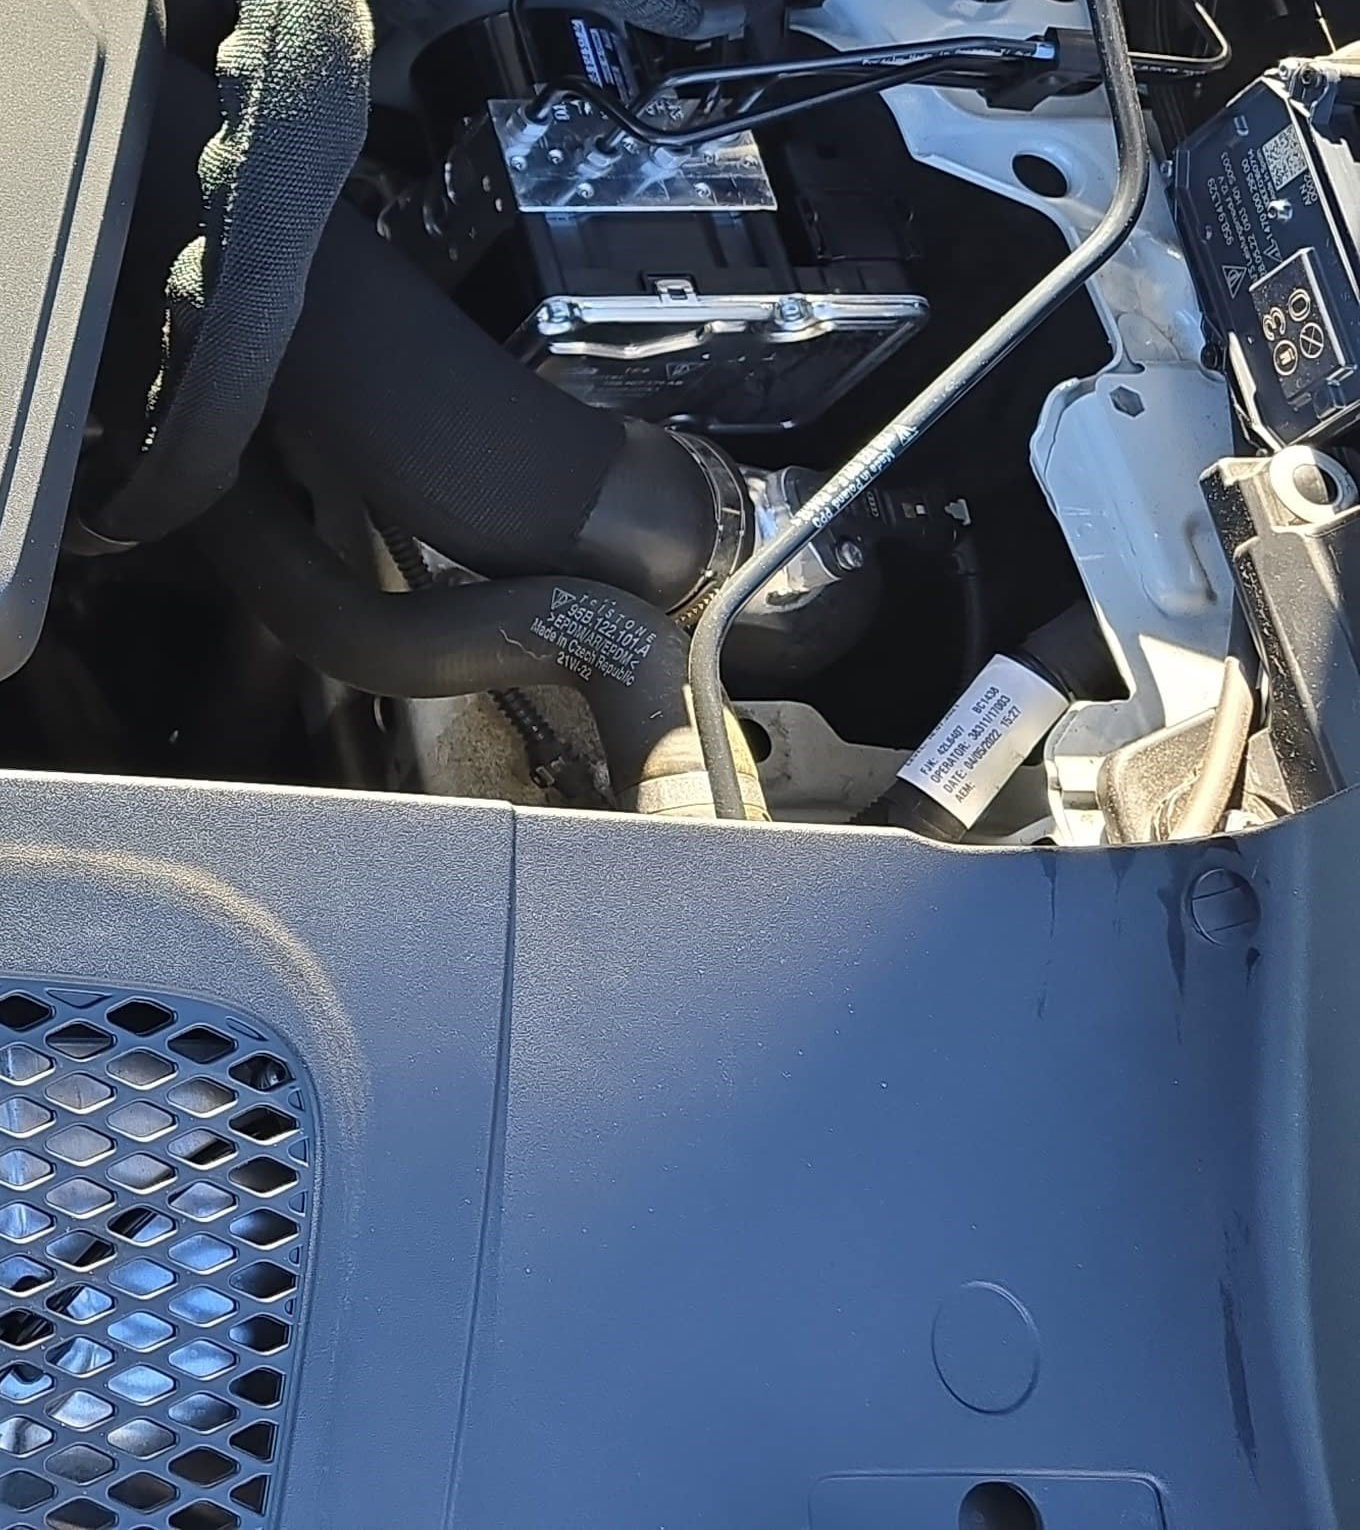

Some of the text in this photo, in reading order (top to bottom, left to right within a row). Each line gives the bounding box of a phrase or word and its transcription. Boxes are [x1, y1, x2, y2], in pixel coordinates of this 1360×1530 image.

[529, 617, 558, 643] Made
[566, 638, 597, 664] Czech
[593, 655, 636, 688] Republic
[930, 739, 971, 785] OPERATOR:
[942, 768, 968, 794] DATE:
